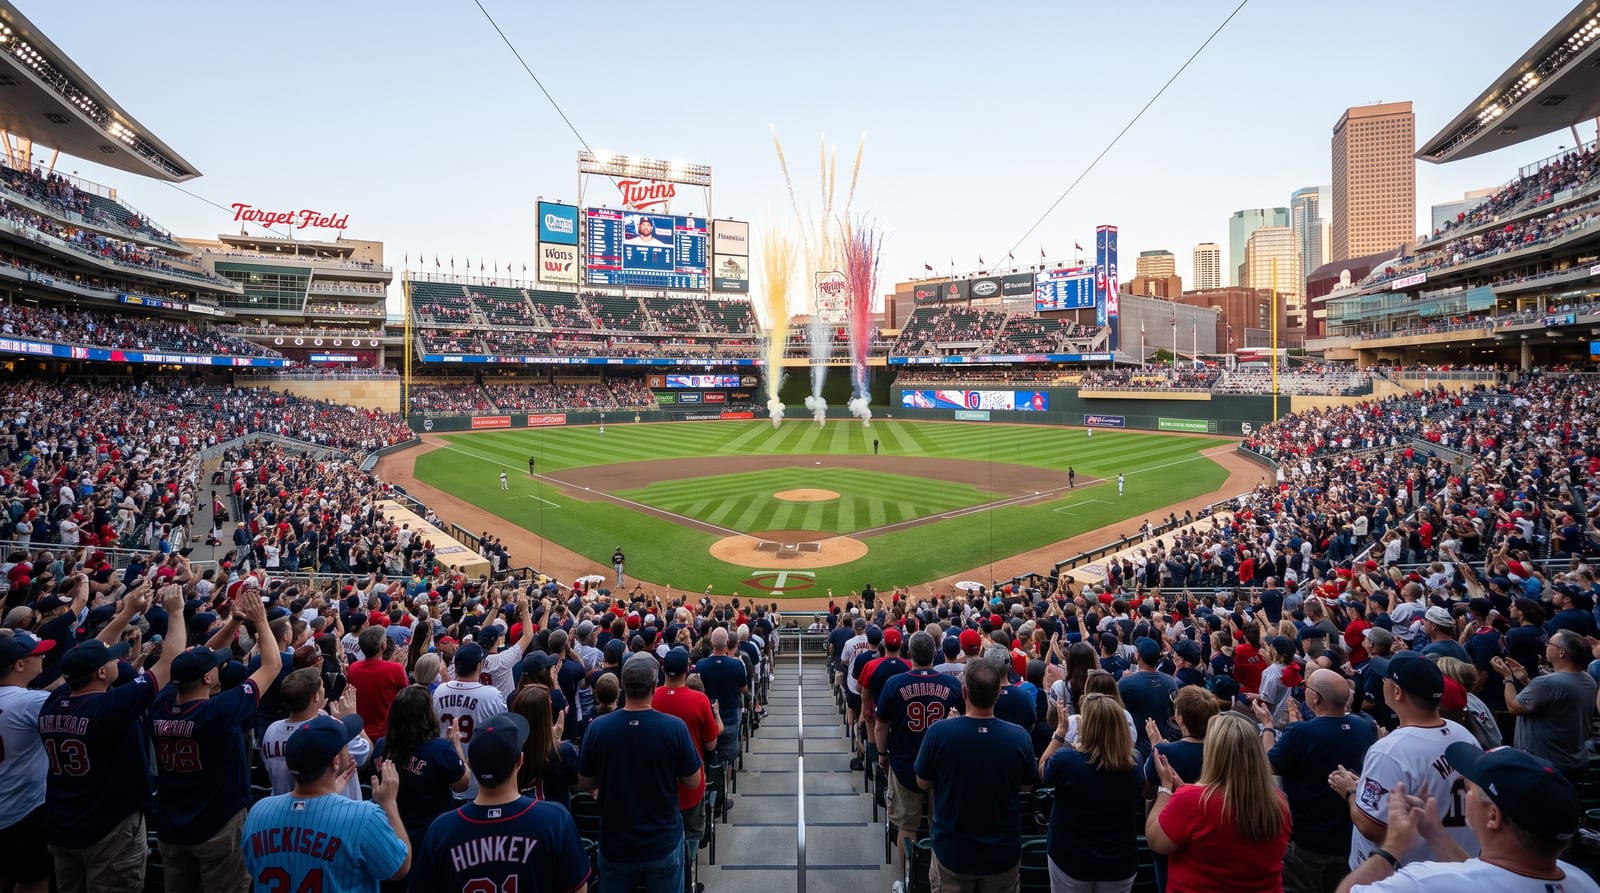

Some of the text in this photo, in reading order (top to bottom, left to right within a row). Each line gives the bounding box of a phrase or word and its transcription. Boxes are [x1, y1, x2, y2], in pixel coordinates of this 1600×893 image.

[618, 179, 676, 206] Twins
[232, 203, 349, 229] Target Field
[907, 702, 945, 732] 92
[45, 739, 91, 776] 13
[450, 835, 538, 872] HUNKEY
